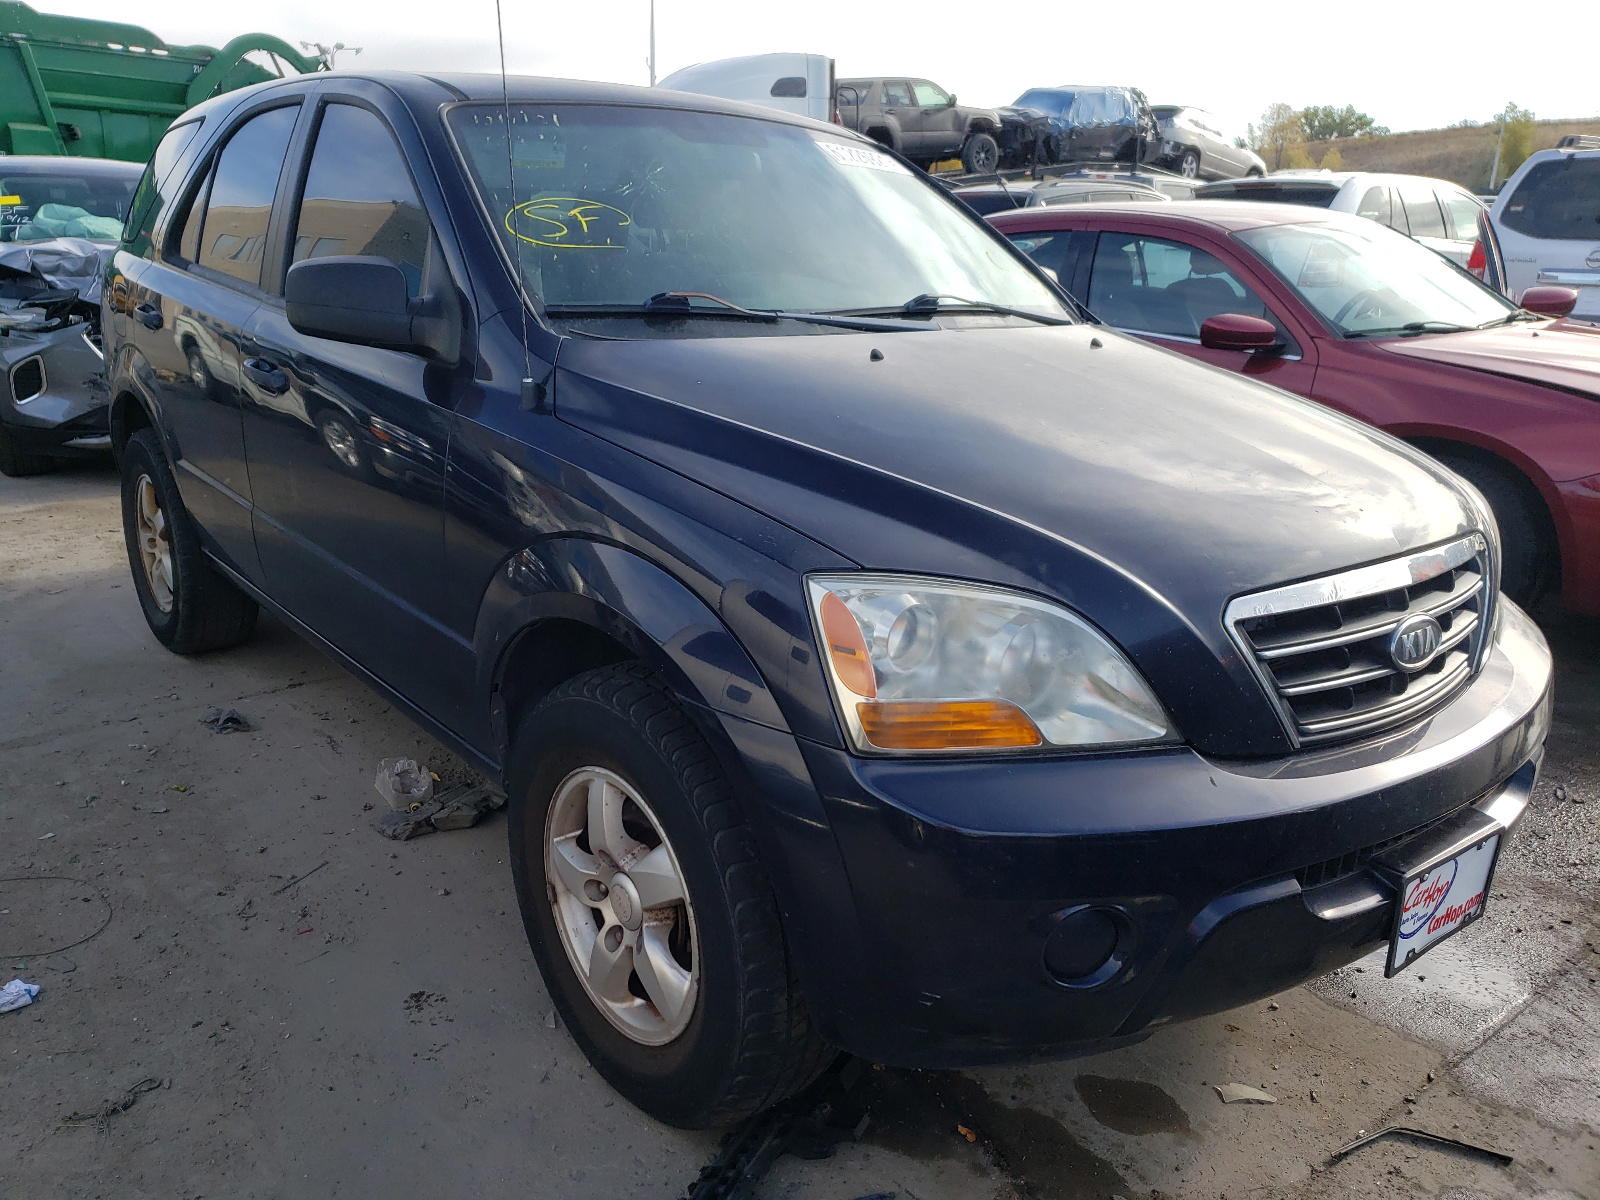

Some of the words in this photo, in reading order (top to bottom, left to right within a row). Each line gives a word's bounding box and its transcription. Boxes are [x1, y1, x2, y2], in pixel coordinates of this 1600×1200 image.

[524, 204, 602, 236] SF
[1401, 626, 1436, 660] KIA
[1402, 874, 1451, 912] CarHop
[1426, 891, 1484, 935] CarHop.com
